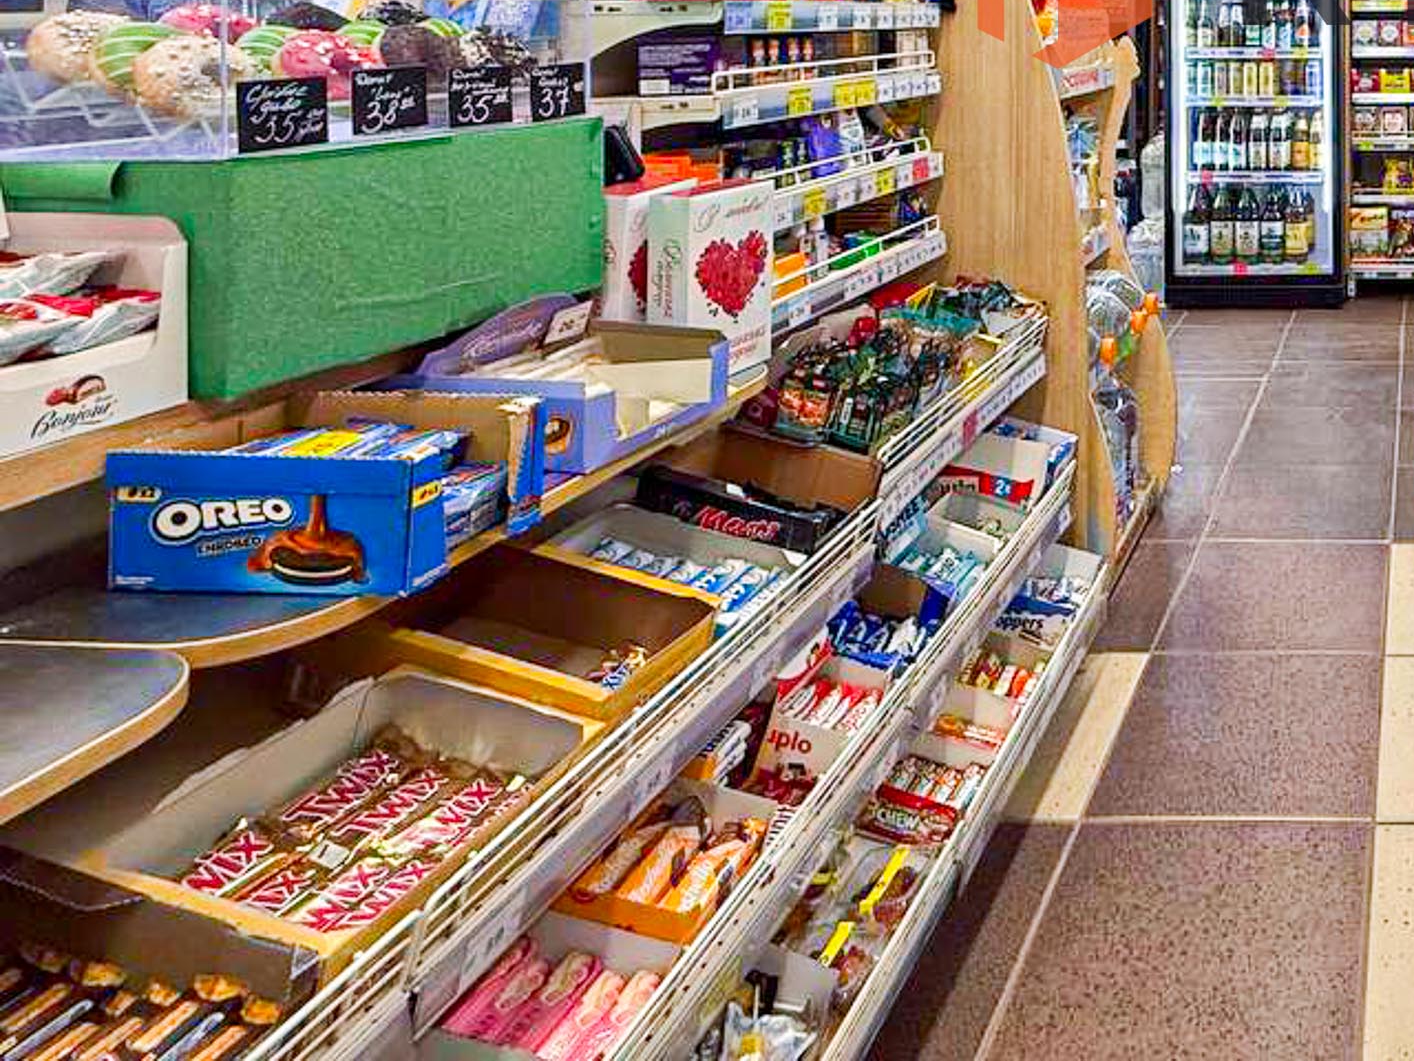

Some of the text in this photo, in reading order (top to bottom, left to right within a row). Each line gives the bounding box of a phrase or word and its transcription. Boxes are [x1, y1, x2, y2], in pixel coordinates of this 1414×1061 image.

[154, 496, 294, 541] OREO
[282, 748, 398, 823] TWIX
[331, 766, 449, 838] TWIX
